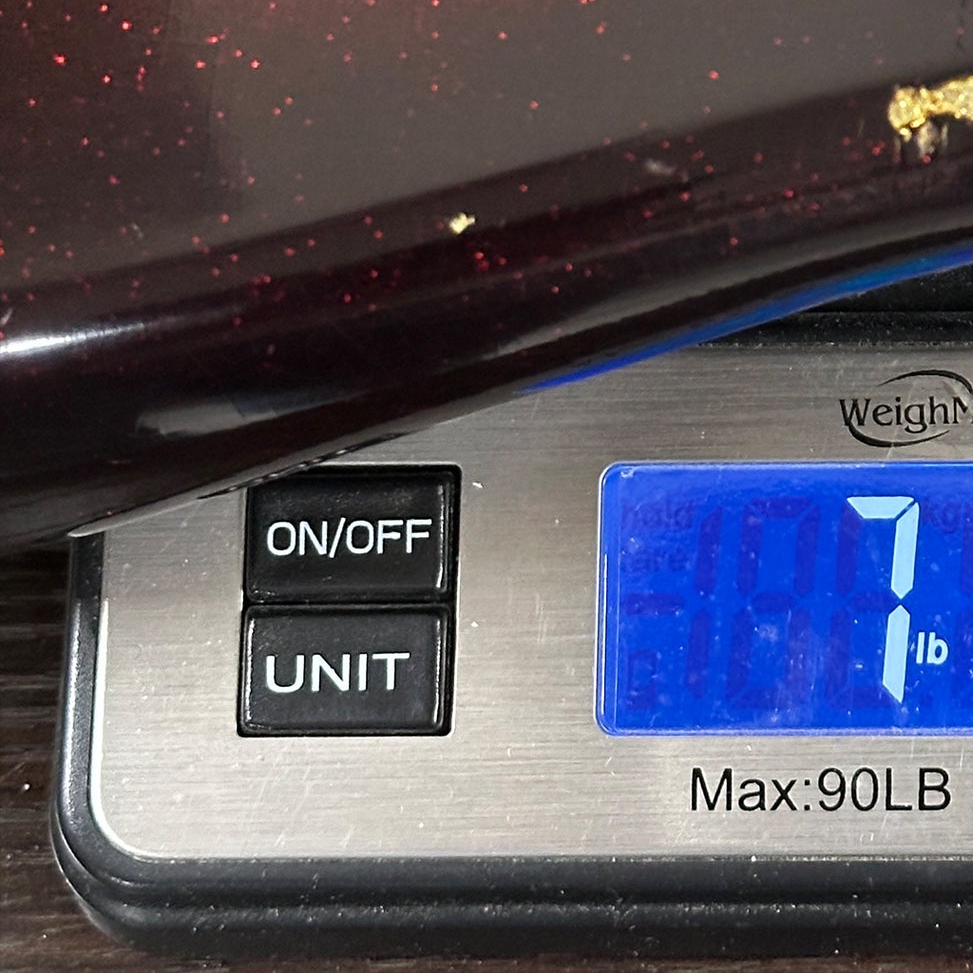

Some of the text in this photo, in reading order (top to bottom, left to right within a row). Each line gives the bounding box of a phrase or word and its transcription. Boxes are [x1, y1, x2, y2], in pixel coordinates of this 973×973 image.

[266, 517, 433, 559] ON/OFF
[846, 494, 920, 704] 7
[916, 631, 948, 666] lb
[265, 652, 411, 694] UNIT
[690, 767, 952, 812] Max:90LB
